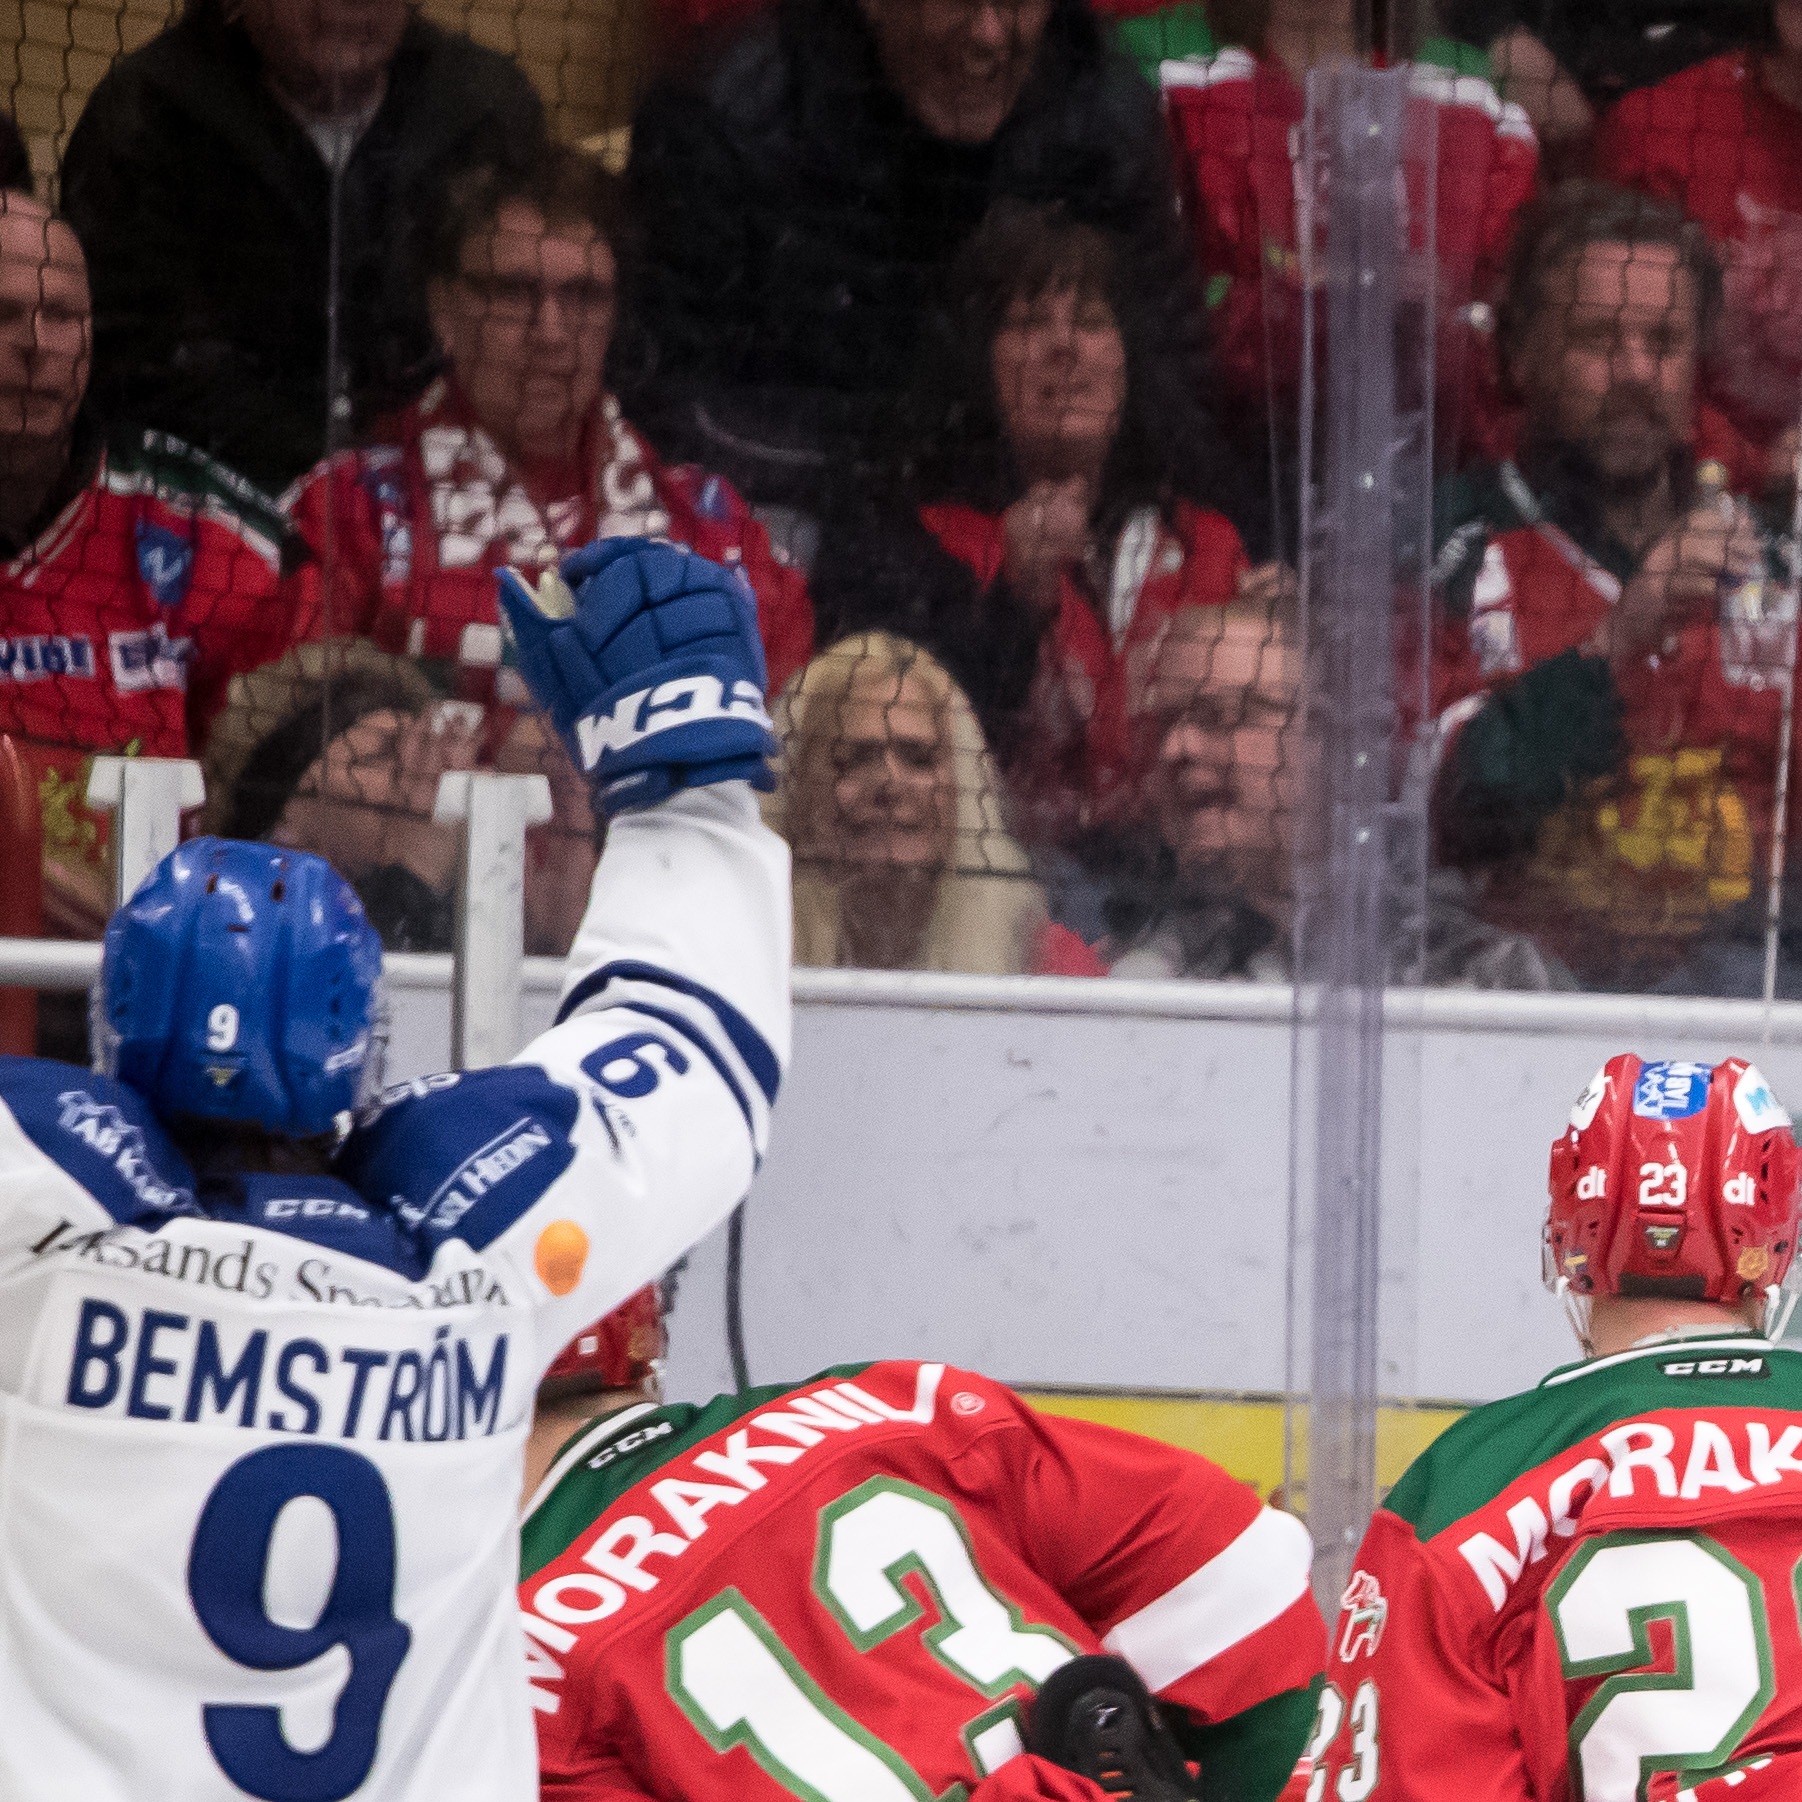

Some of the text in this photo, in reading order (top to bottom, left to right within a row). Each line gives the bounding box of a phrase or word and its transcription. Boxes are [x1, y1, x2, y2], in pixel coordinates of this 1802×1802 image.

[207, 1003, 240, 1053] 9
[1638, 1162, 1688, 1207] 23
[66, 1297, 509, 1443] BEMSTRÖM
[1664, 1357, 1763, 1378] CCM
[587, 1420, 674, 1470] CCM
